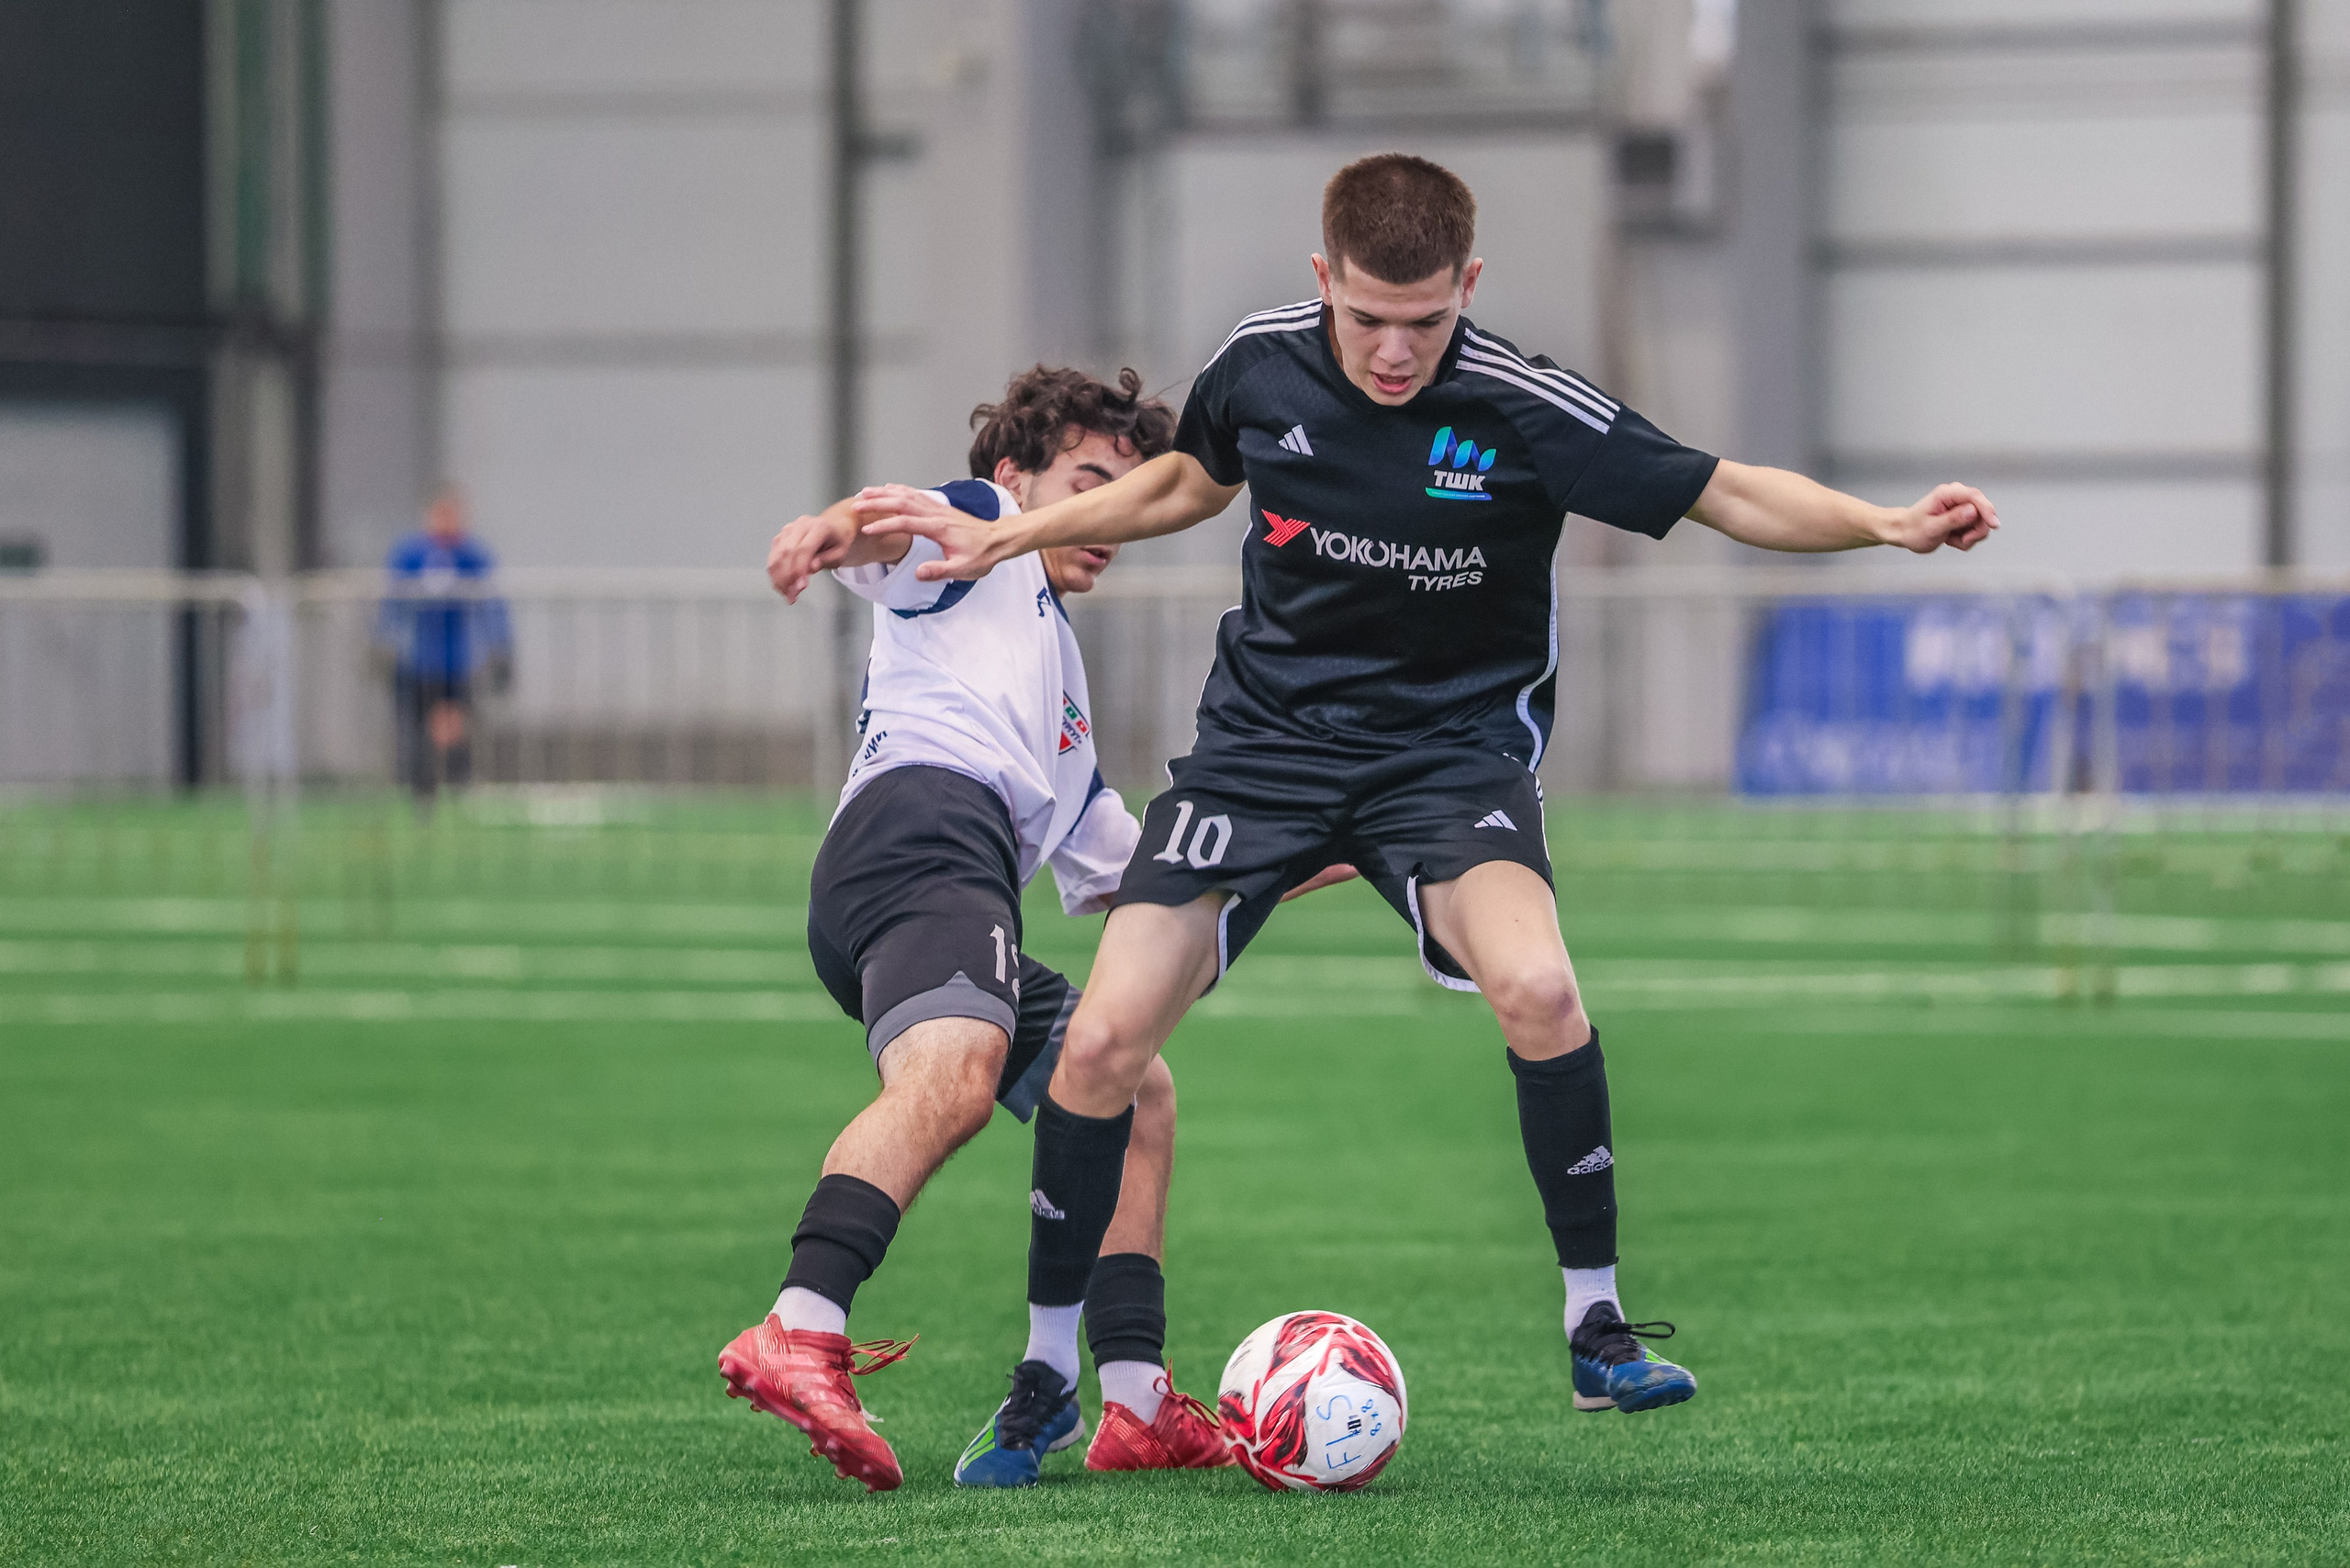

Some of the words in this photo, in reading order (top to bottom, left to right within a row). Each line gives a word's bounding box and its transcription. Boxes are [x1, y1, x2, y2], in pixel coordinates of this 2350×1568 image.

[1434, 470, 1486, 491] ТШК
[1310, 527, 1487, 571] YOKOHAMA
[1408, 571, 1483, 591] TYRES
[1153, 800, 1233, 868] 10
